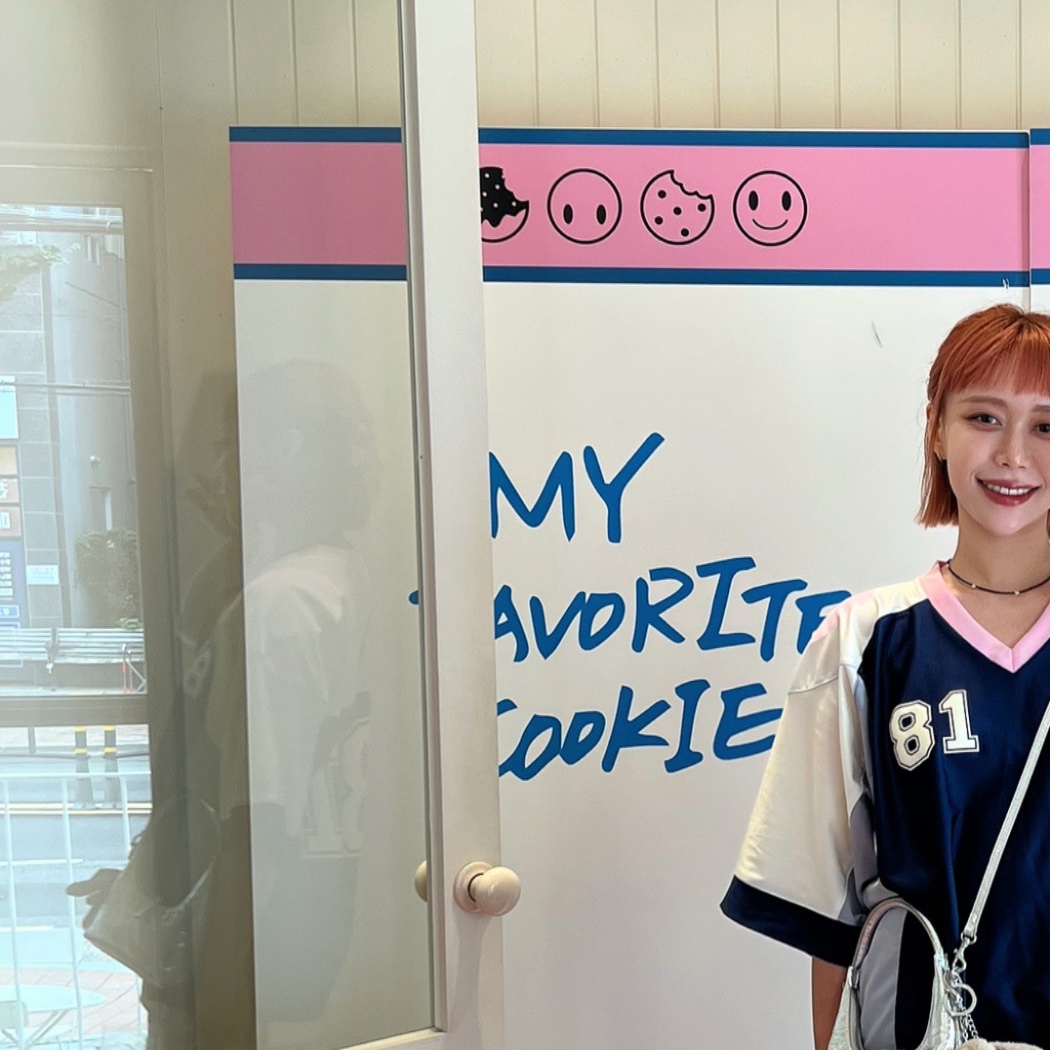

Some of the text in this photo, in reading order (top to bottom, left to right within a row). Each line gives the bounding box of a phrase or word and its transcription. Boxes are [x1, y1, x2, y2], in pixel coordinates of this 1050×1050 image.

[489, 432, 665, 543] MY
[409, 557, 852, 662] AVORITE
[889, 689, 980, 771] 81
